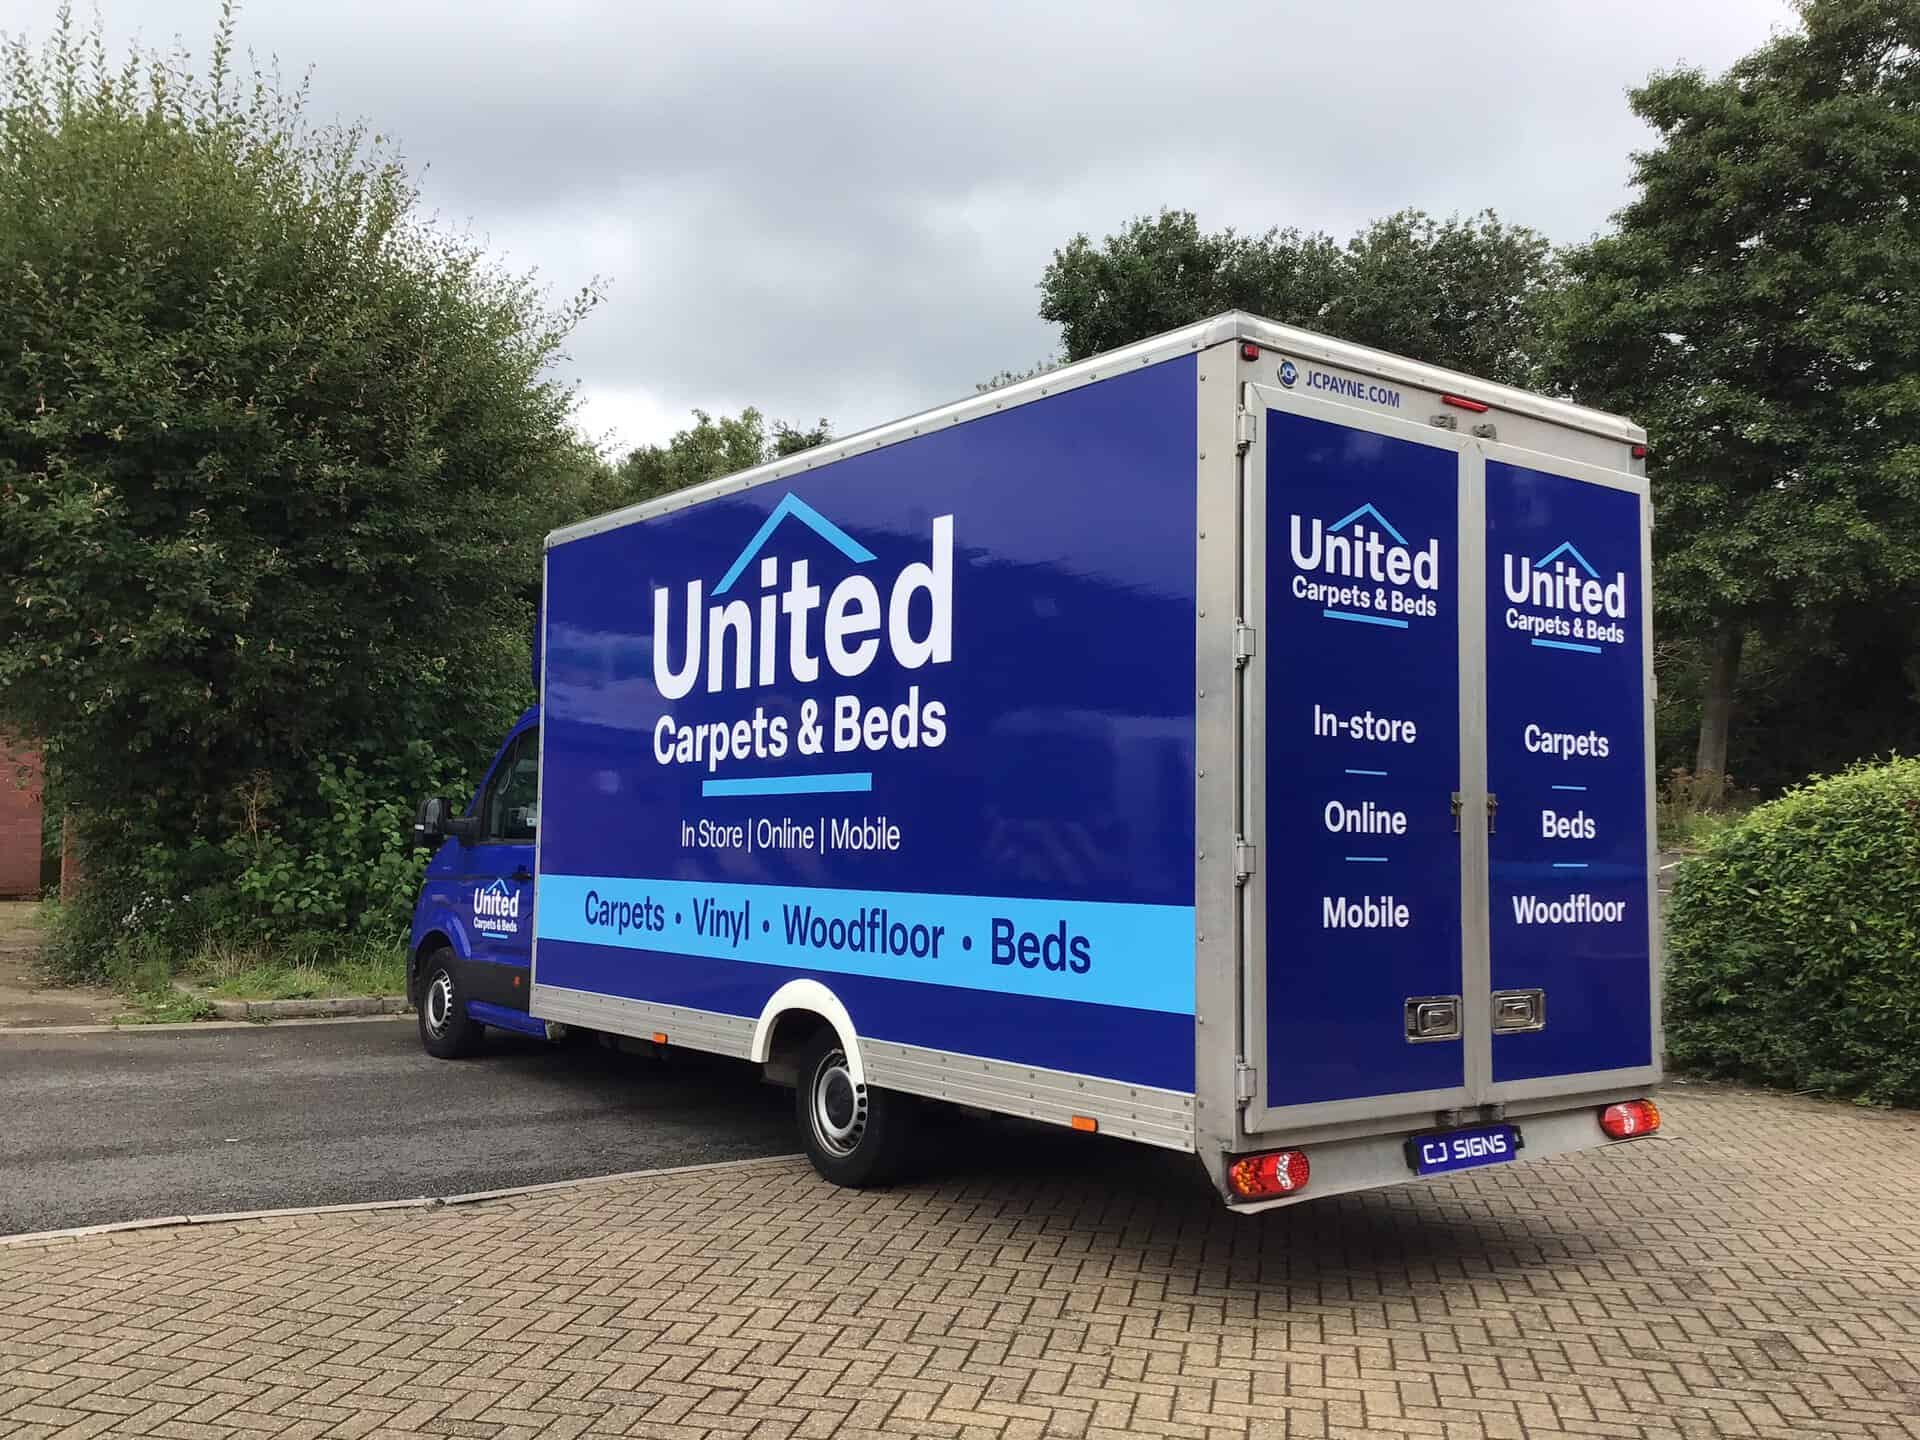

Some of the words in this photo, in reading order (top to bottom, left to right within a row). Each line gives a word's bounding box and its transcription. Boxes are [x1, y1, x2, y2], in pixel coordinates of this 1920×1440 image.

[1306, 370, 1400, 408] JCPAYNE.COM
[1290, 514, 1439, 590] United
[1291, 575, 1371, 609] Carpets
[1374, 587, 1388, 611] &
[1391, 590, 1437, 617] Beds
[1504, 553, 1626, 619] United
[653, 514, 954, 700] United
[1505, 607, 1571, 637] Carpets
[1573, 617, 1585, 638] &
[1586, 619, 1625, 644] Beds
[653, 706, 788, 772] Carpets
[798, 698, 824, 755] &
[834, 685, 947, 753] Beds
[1314, 704, 1417, 744] In-store
[1524, 724, 1609, 761] Carpets
[681, 819, 695, 847] In
[698, 818, 743, 849] Store
[756, 816, 815, 850] Online
[831, 816, 901, 851] Mobile
[1324, 800, 1407, 835] Online
[1542, 810, 1596, 839] Beds
[473, 887, 520, 917] United
[1323, 895, 1410, 928] Mobile
[1513, 893, 1626, 924] Woodfloor
[473, 916, 496, 931] Carpets
[501, 919, 518, 933] Beds
[585, 890, 665, 936] Carpets
[692, 897, 750, 948] Vinyl
[783, 904, 945, 959] Woodfloor
[991, 917, 1091, 975] Beds
[1423, 1142, 1449, 1164] CJ
[1453, 1134, 1507, 1159] SIGNS
